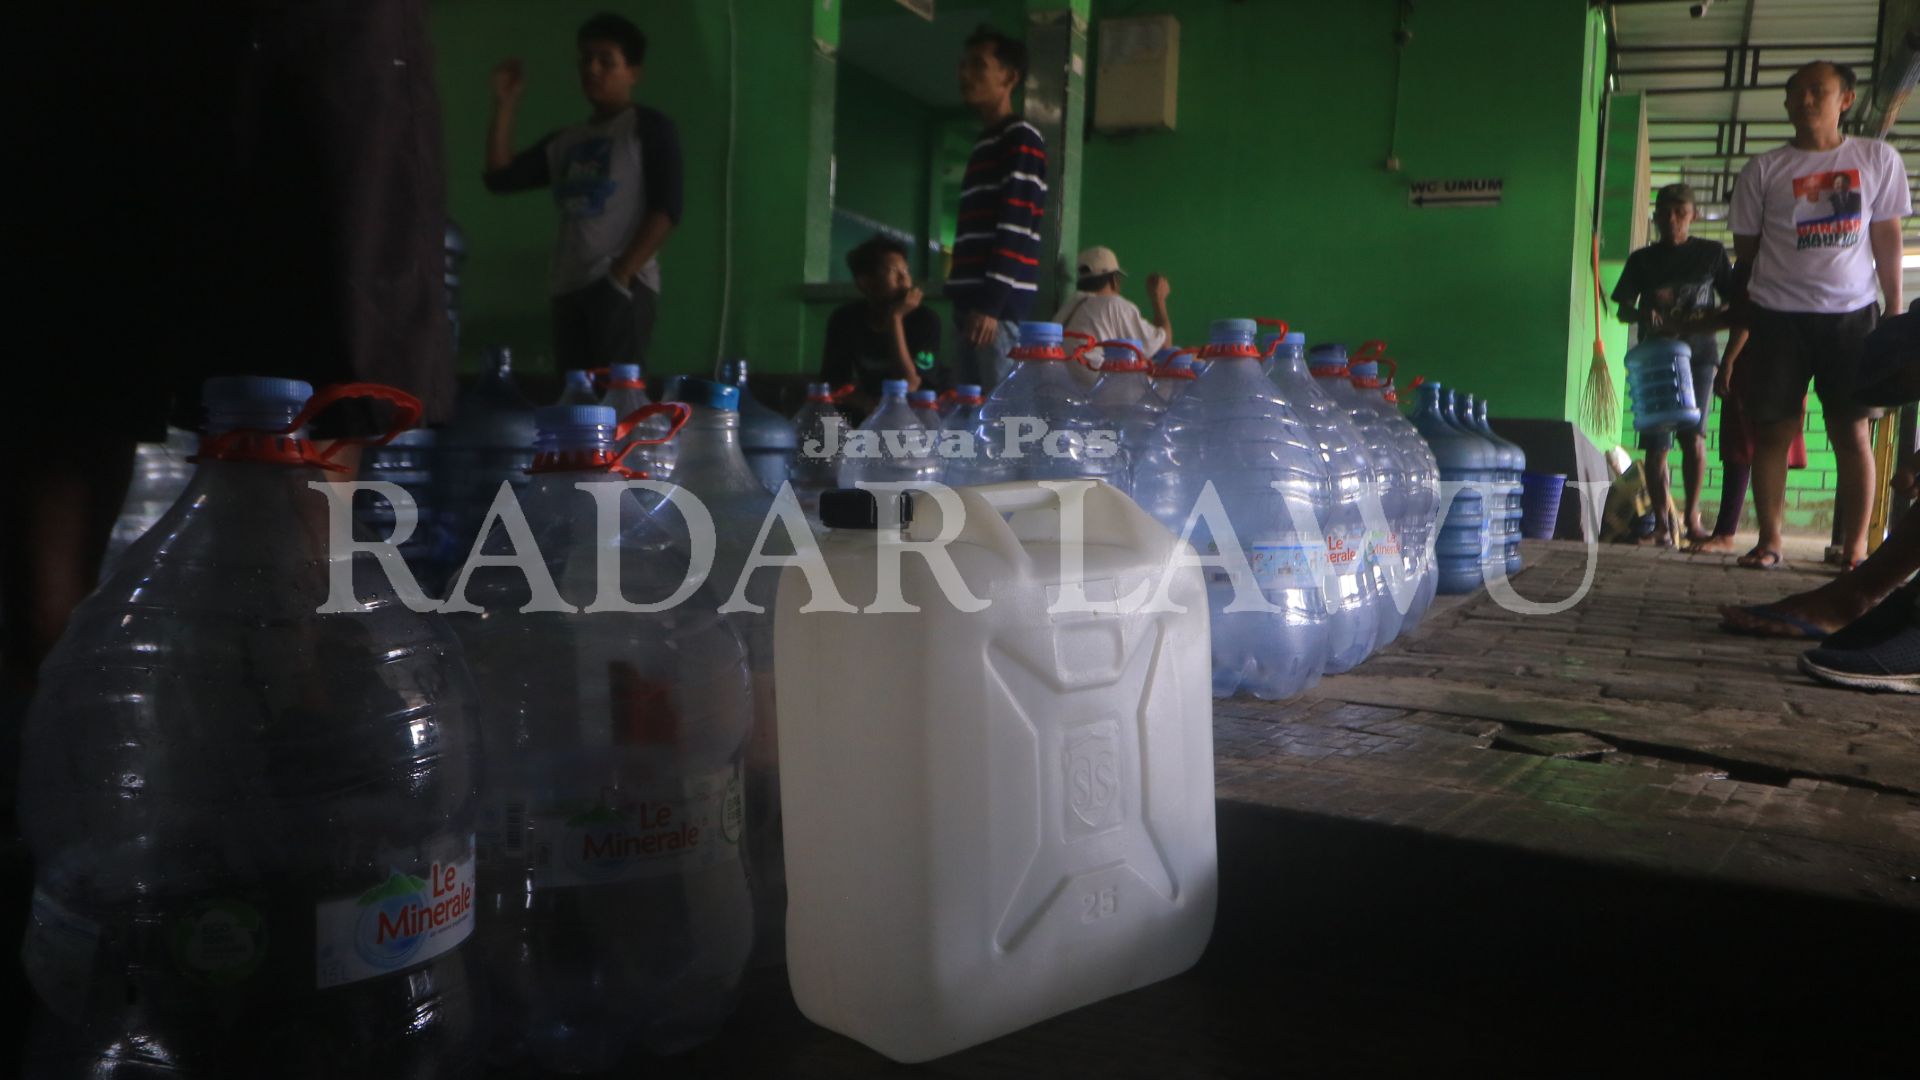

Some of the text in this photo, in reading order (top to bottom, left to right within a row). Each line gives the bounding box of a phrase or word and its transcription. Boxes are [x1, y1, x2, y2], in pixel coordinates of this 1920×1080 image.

[1410, 179, 1504, 193] WC UMUM
[1327, 535, 1344, 551] Le
[639, 802, 673, 830] Le
[582, 822, 700, 861] Minerale
[432, 863, 457, 898] Le
[375, 882, 471, 945] Minerale
